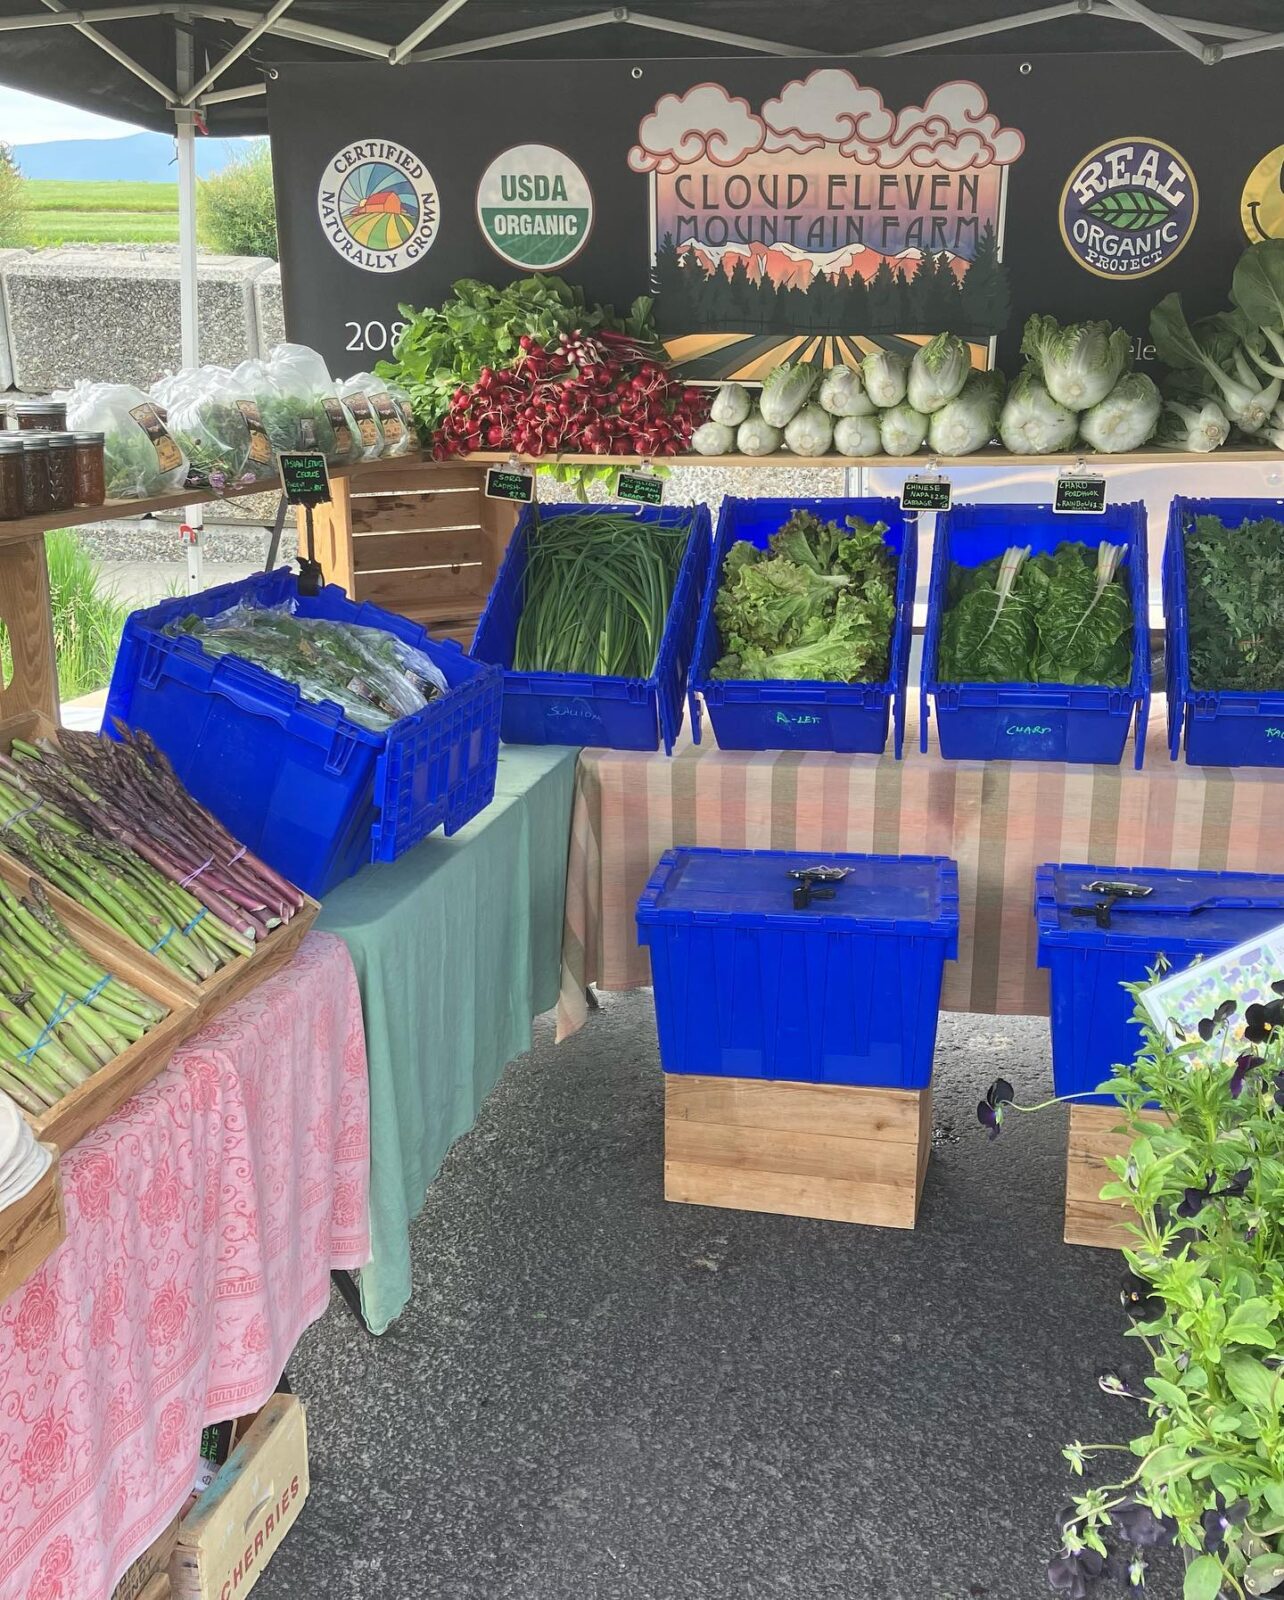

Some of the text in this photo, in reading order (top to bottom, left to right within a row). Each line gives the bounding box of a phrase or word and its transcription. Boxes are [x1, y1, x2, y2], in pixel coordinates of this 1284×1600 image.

[333, 142, 423, 179] CERTIFIED
[1071, 146, 1187, 207] REAL
[500, 174, 569, 202] USDA
[674, 173, 980, 214] CLOUD ELEVEN
[322, 190, 437, 269] NATURALLY GROWN
[493, 214, 578, 236] ORGANIC
[675, 214, 980, 251] MOUNTAIN FARM
[1072, 218, 1179, 257] ORGANIC
[1084, 249, 1163, 272] PROJECT
[905, 484, 941, 492] CHINESE
[909, 491, 930, 499] NAPA
[220, 1474, 300, 1600] CHERRIES
